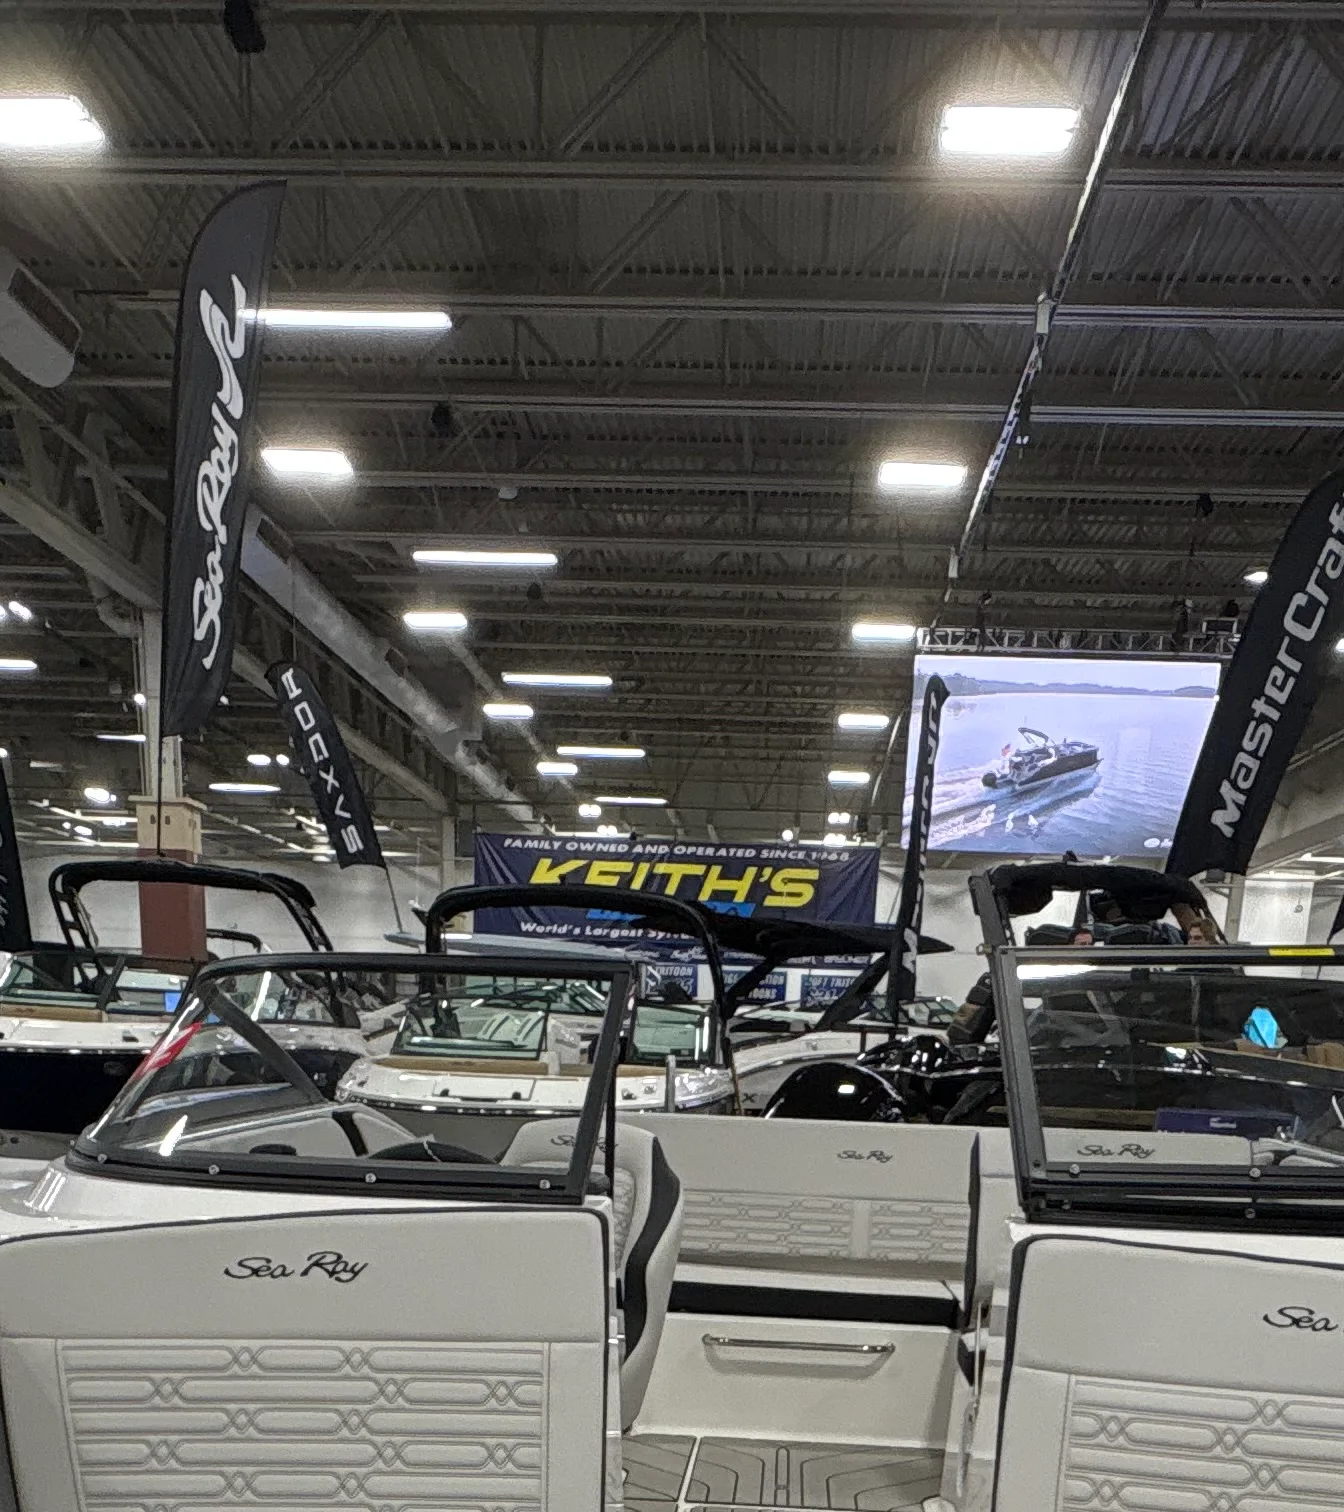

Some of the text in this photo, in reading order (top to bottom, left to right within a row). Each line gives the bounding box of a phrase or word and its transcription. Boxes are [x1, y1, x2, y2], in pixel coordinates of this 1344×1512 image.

[193, 403, 240, 671] Sea Ray
[504, 837, 561, 850] FAMILY
[565, 841, 628, 854] OWNED
[632, 843, 672, 856] AND
[674, 845, 756, 858] OPERATED
[759, 848, 805, 860] SINCE
[529, 857, 820, 907] KEITH'S
[520, 921, 580, 936] World's
[585, 925, 644, 940] Largest
[1076, 1144, 1115, 1157] Sea
[223, 1250, 369, 1283] Sea Ray
[1262, 1305, 1340, 1332] Sea
